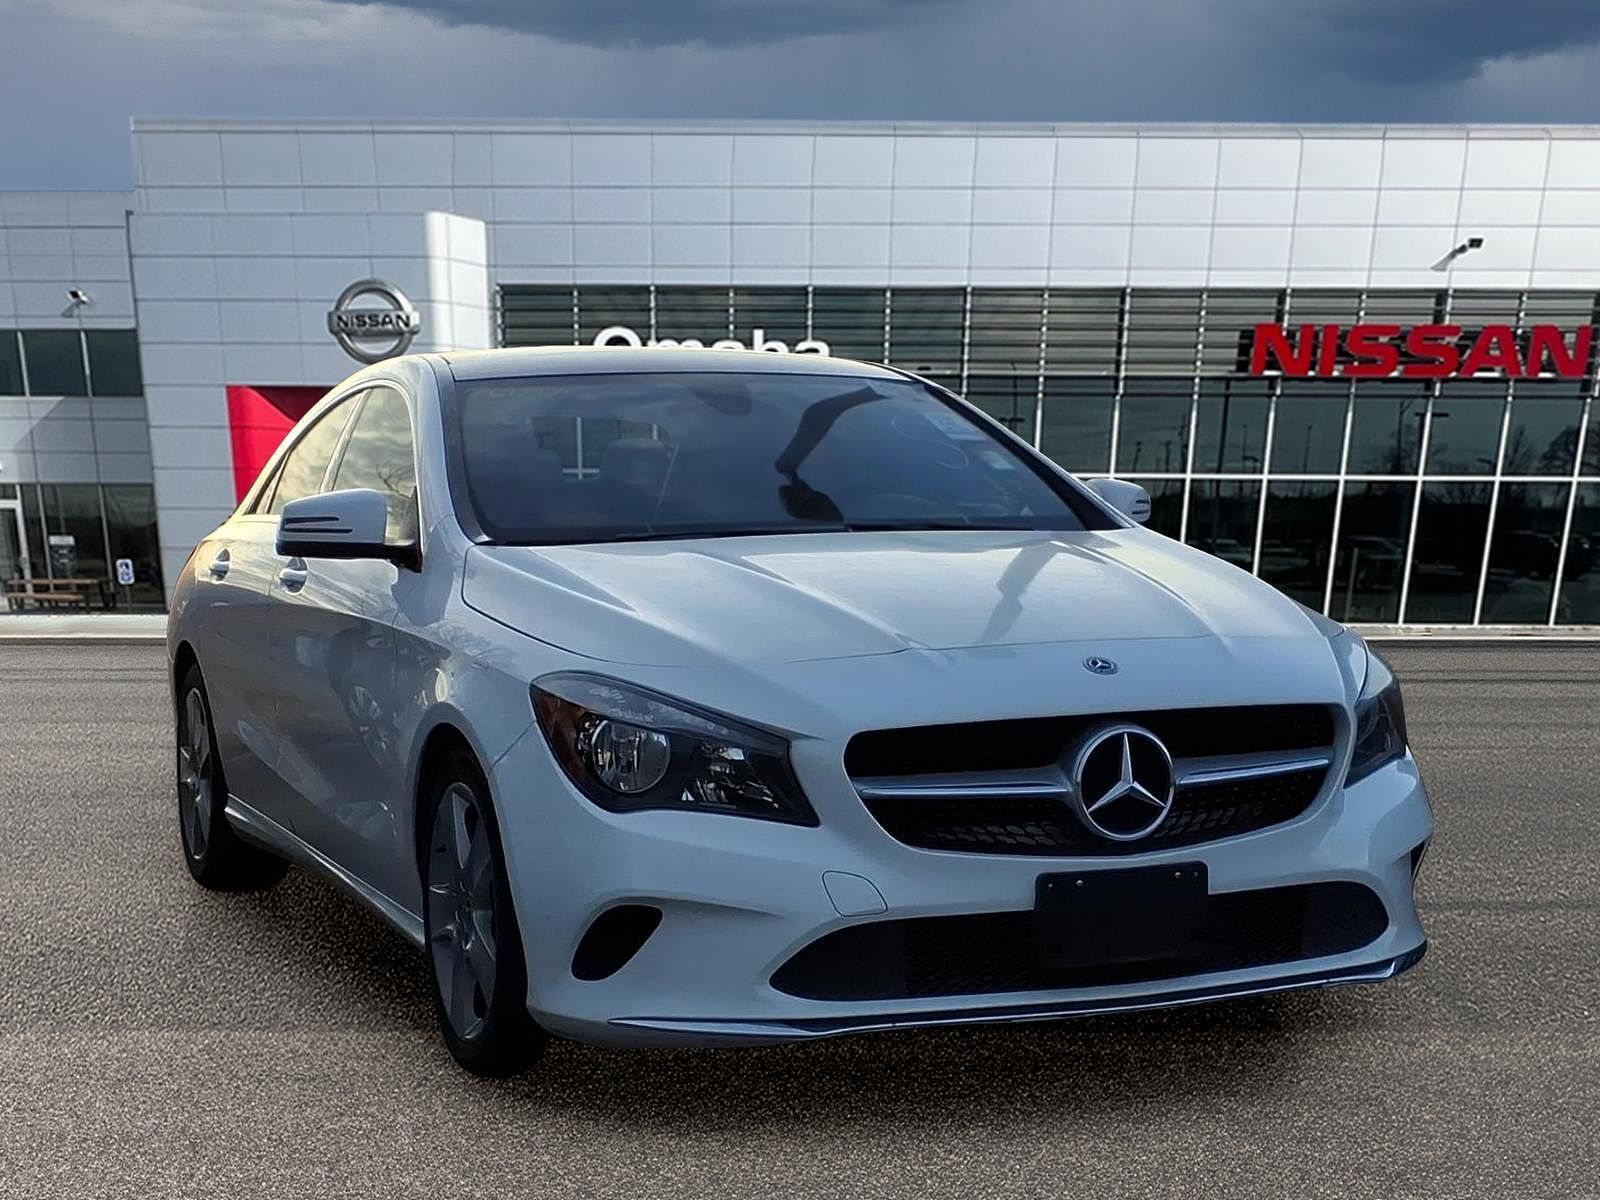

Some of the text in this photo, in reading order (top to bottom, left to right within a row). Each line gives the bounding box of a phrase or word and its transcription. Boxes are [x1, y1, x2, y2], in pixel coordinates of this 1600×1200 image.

[336, 313, 410, 328] NISSAN
[593, 326, 830, 357] Oha
[1250, 323, 1593, 377] NISSAN
